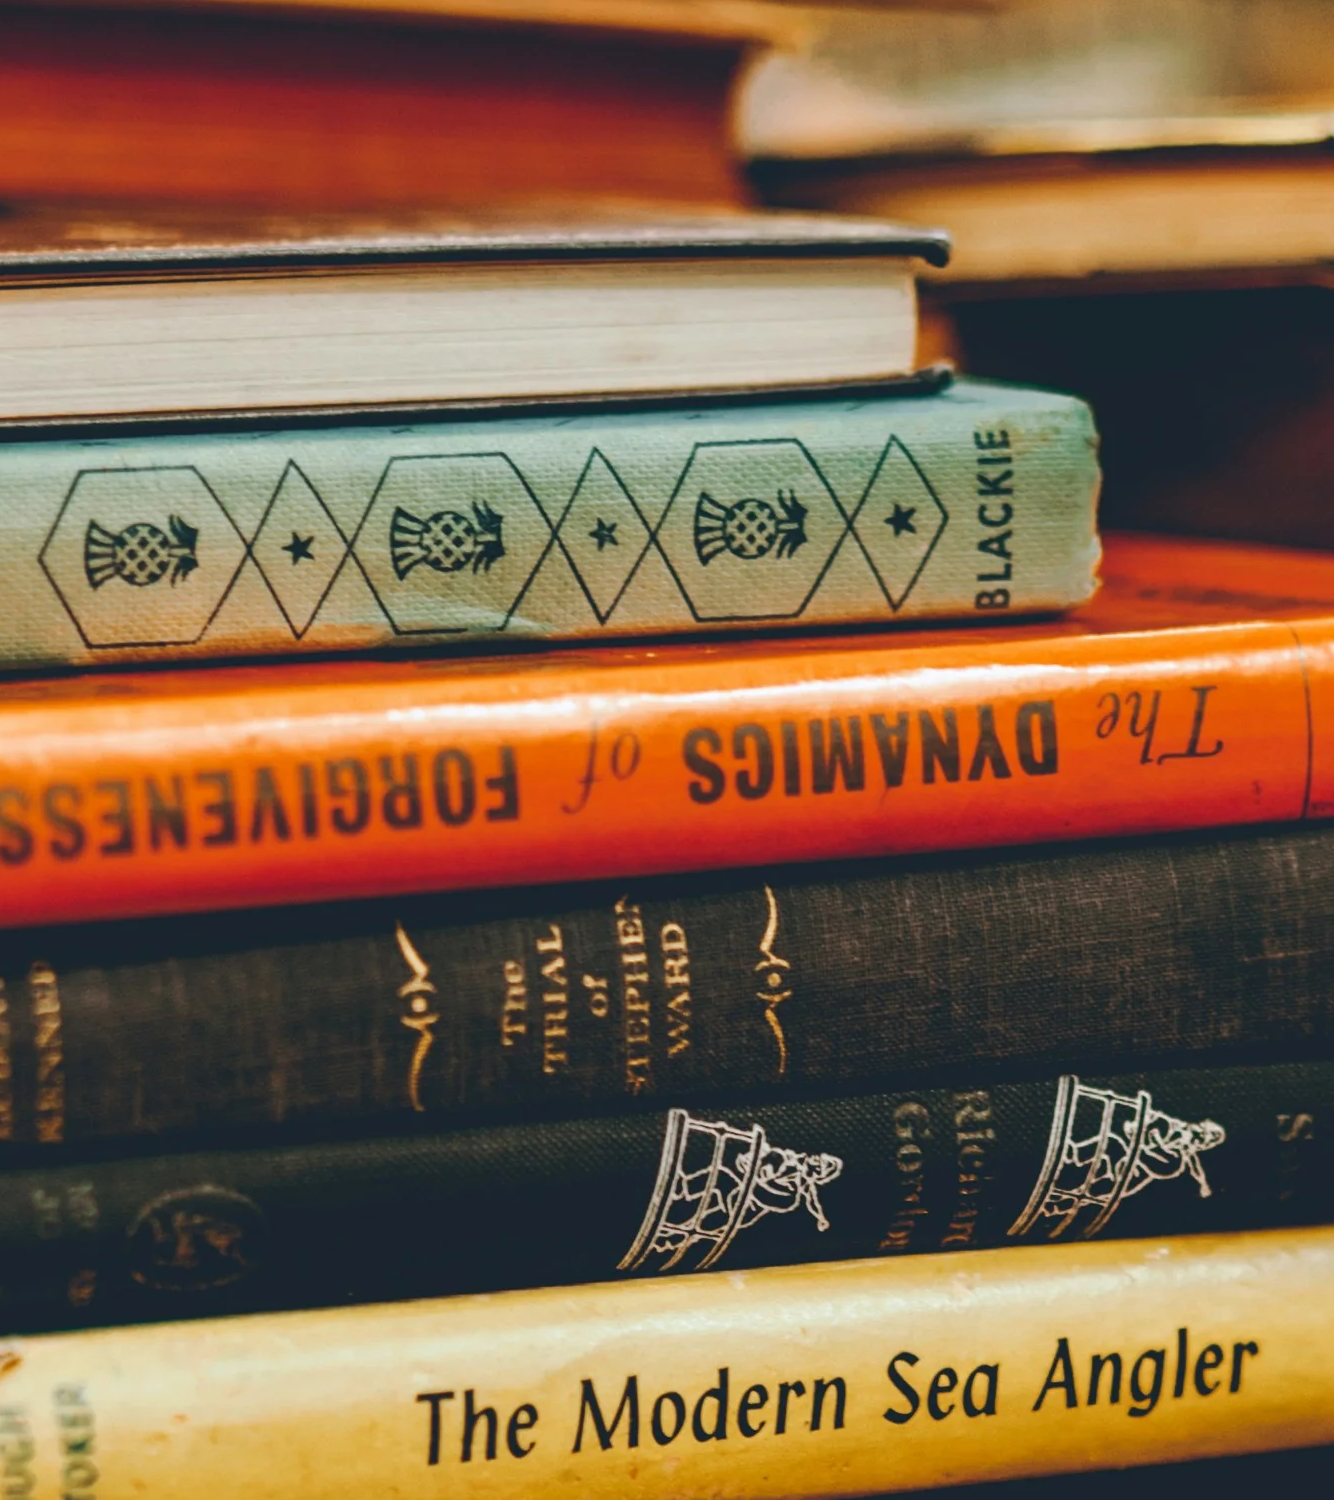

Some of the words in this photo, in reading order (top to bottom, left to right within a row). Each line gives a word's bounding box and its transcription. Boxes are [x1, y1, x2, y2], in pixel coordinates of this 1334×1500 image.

[973, 429, 1014, 610] BLACKIE
[559, 722, 641, 814] of
[684, 700, 1060, 805] DYNAMICS
[1095, 683, 1224, 767] The
[500, 959, 528, 1048] The
[536, 923, 569, 1075] TRIAL
[582, 973, 609, 1019] of
[659, 921, 692, 1059] WARD
[415, 1388, 539, 1467] The
[571, 1366, 849, 1454] Modern
[881, 1350, 1002, 1426] Sea
[1032, 1326, 1260, 1419] Angler
